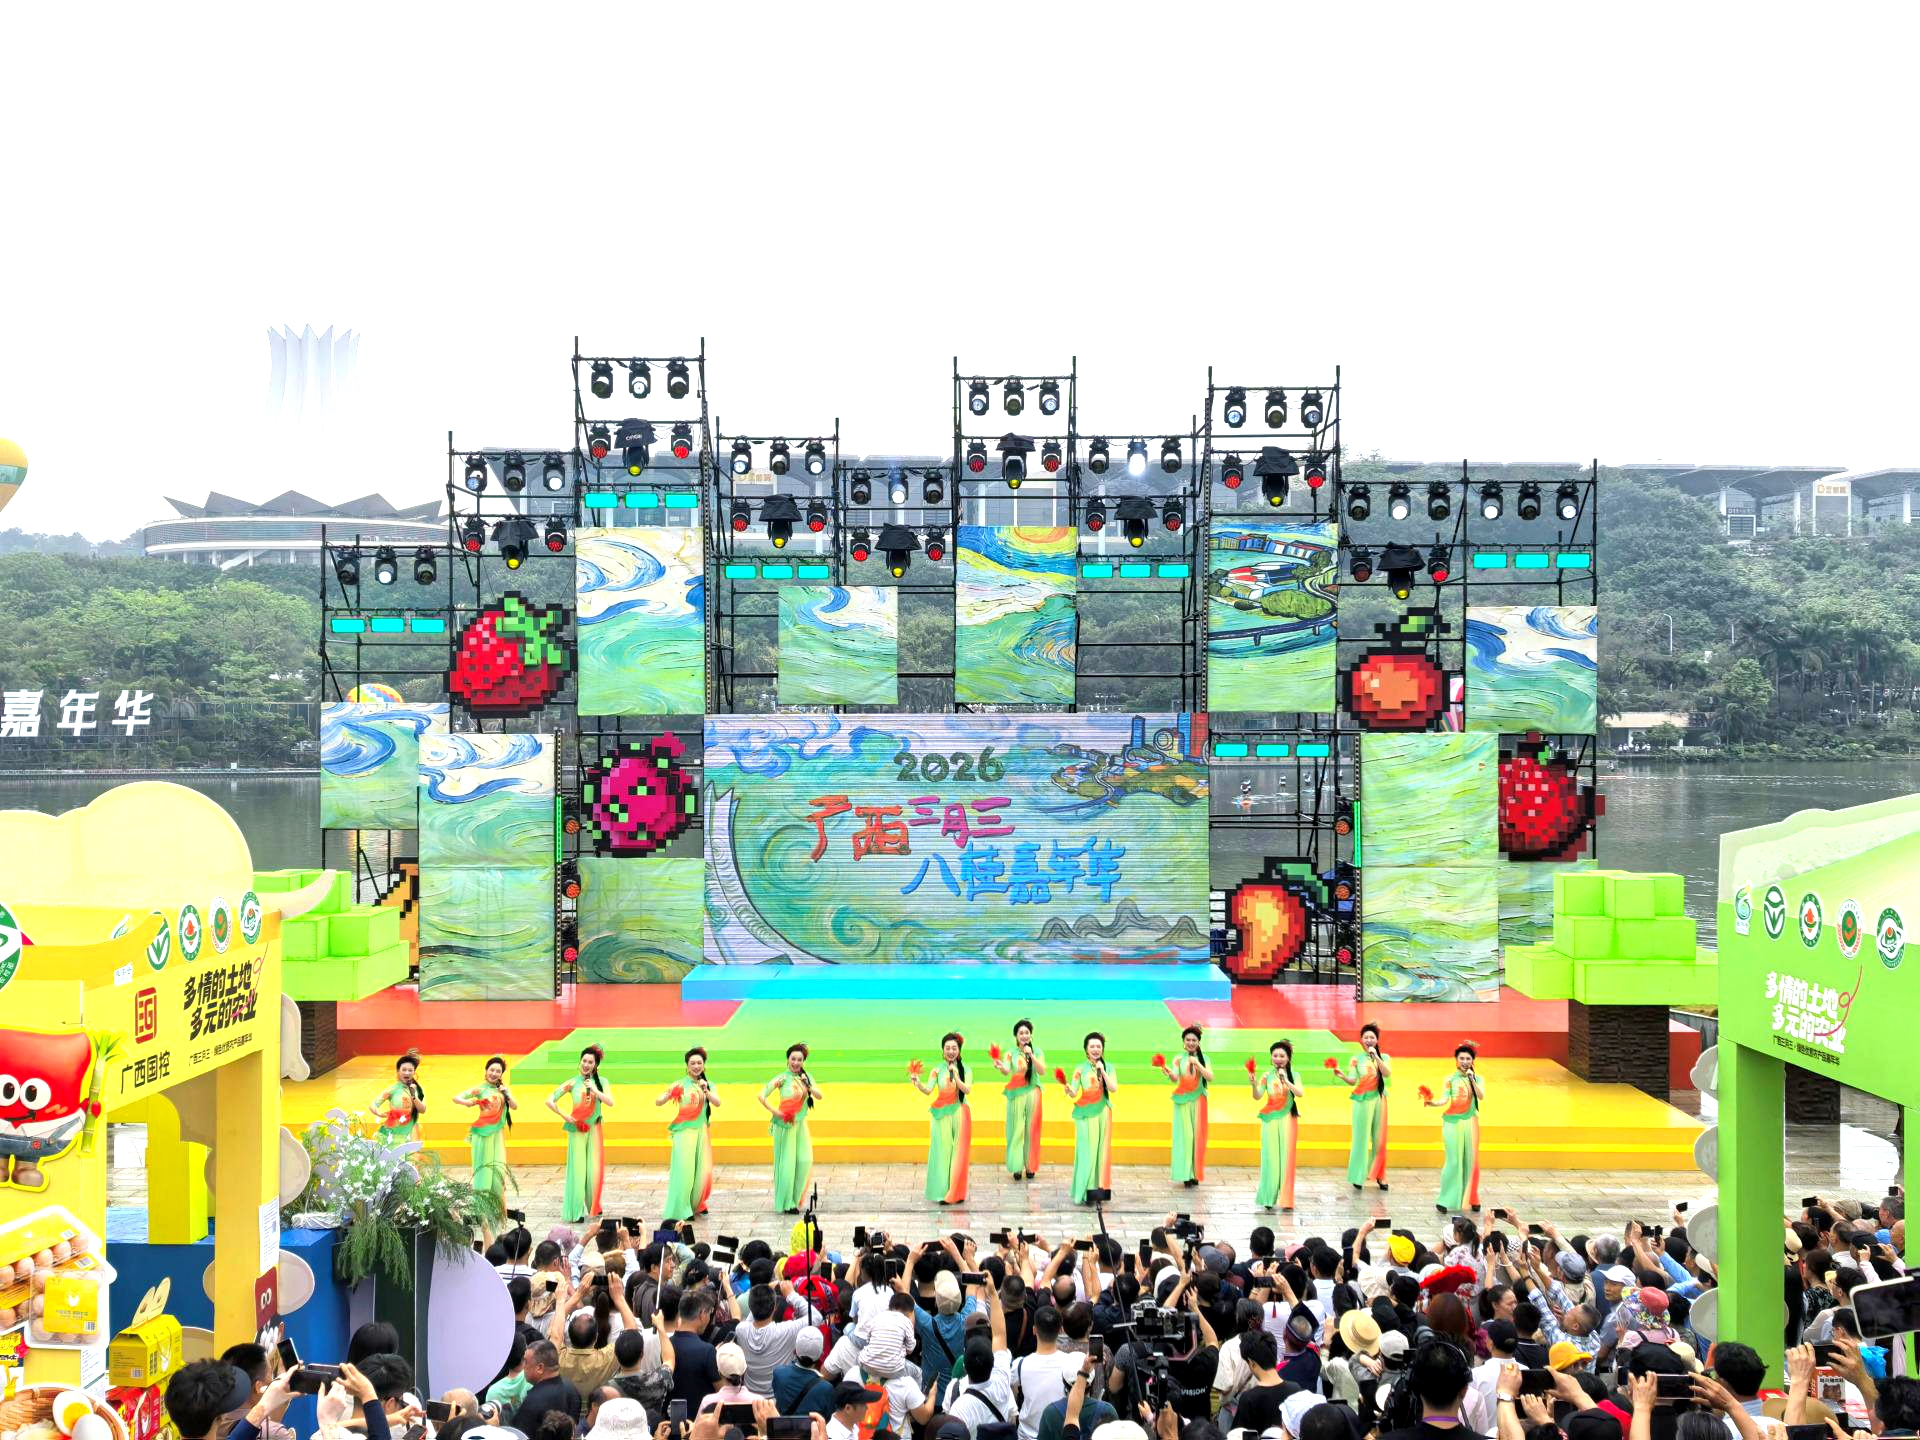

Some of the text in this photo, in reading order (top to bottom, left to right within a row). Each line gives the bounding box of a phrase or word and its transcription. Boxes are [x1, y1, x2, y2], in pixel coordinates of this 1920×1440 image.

[0, 689, 154, 738] 嘉年华
[893, 746, 1006, 783] 2026
[805, 794, 1017, 861] 广西三月三
[900, 836, 1126, 905] 八桂嘉年华
[183, 960, 253, 1010] 多情的土地
[1765, 971, 1839, 1020] 多情的土地
[189, 989, 259, 1041] 多元的农业
[1771, 1003, 1847, 1054] 多元的农业
[120, 1050, 171, 1095] 广西国控
